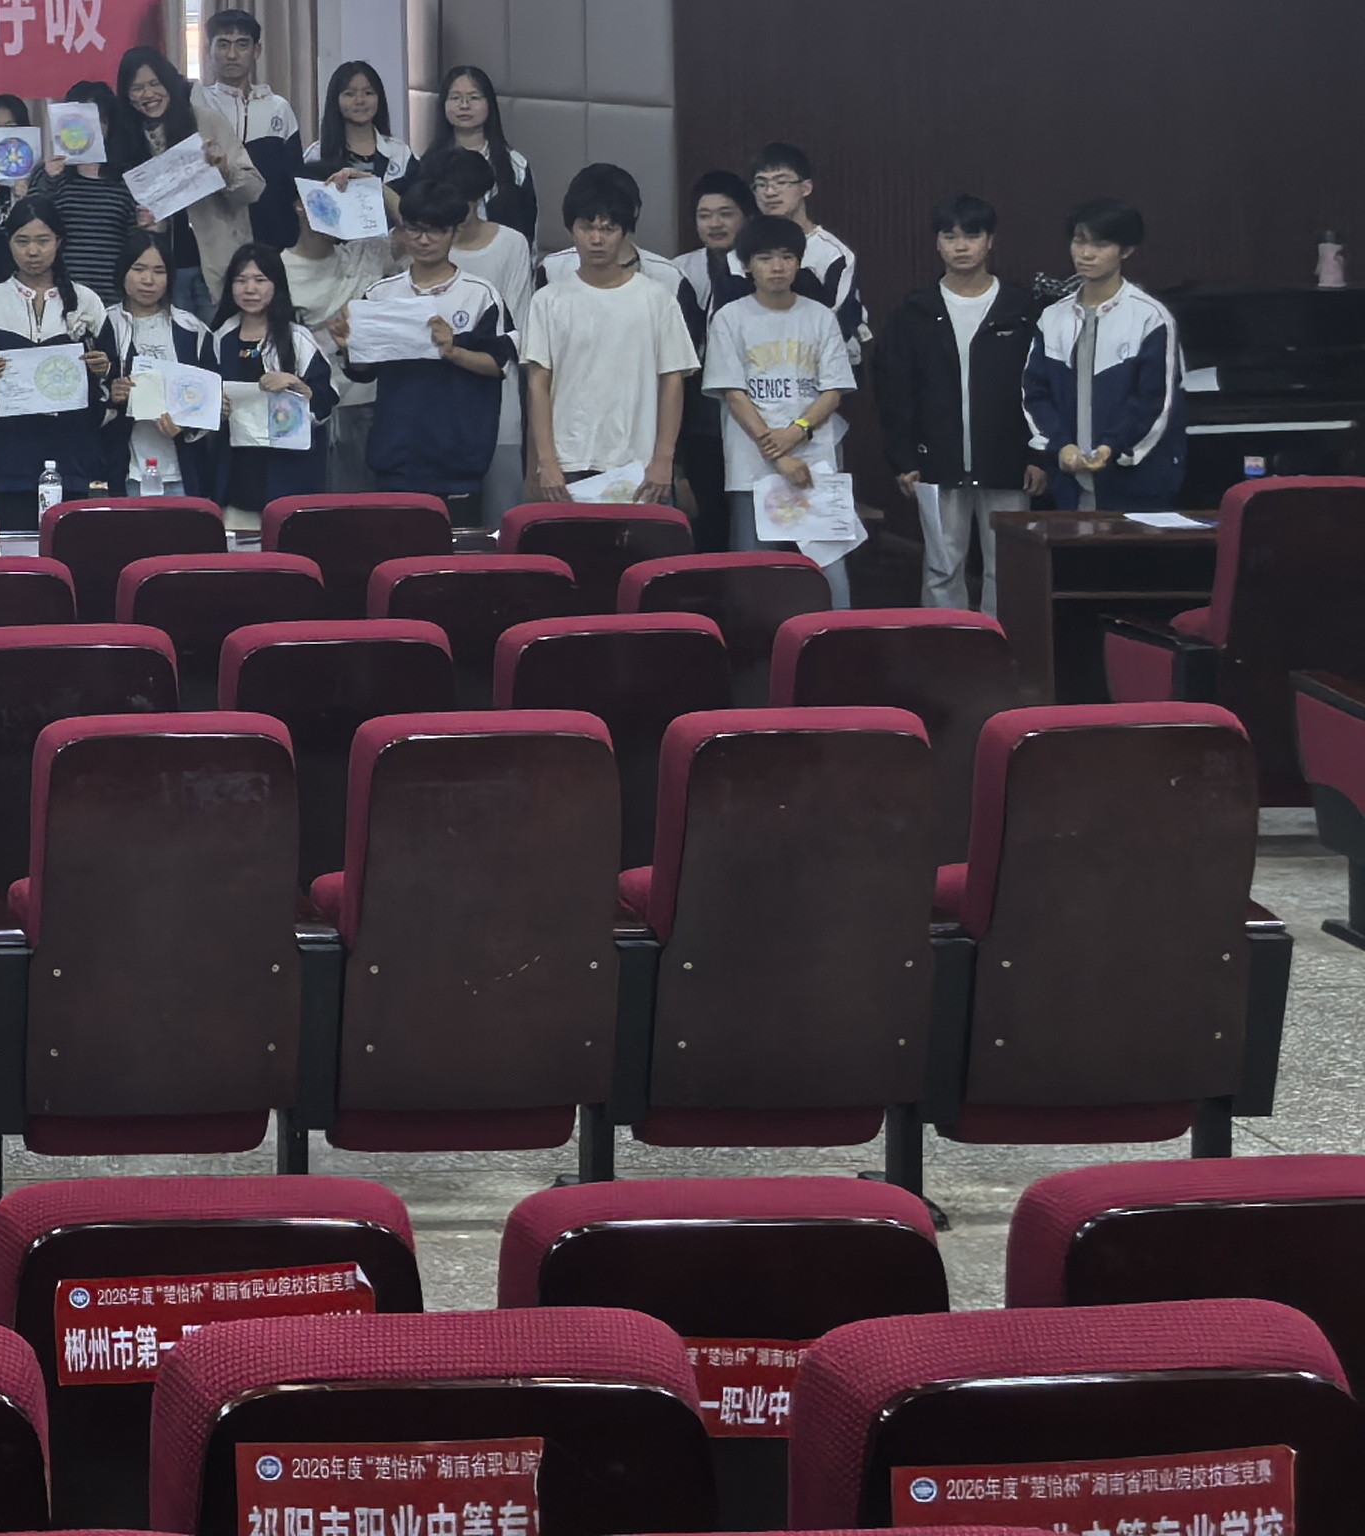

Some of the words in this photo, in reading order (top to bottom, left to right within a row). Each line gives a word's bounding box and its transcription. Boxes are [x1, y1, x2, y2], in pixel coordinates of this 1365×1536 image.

[65, 1324, 201, 1373] 郴州市第一
